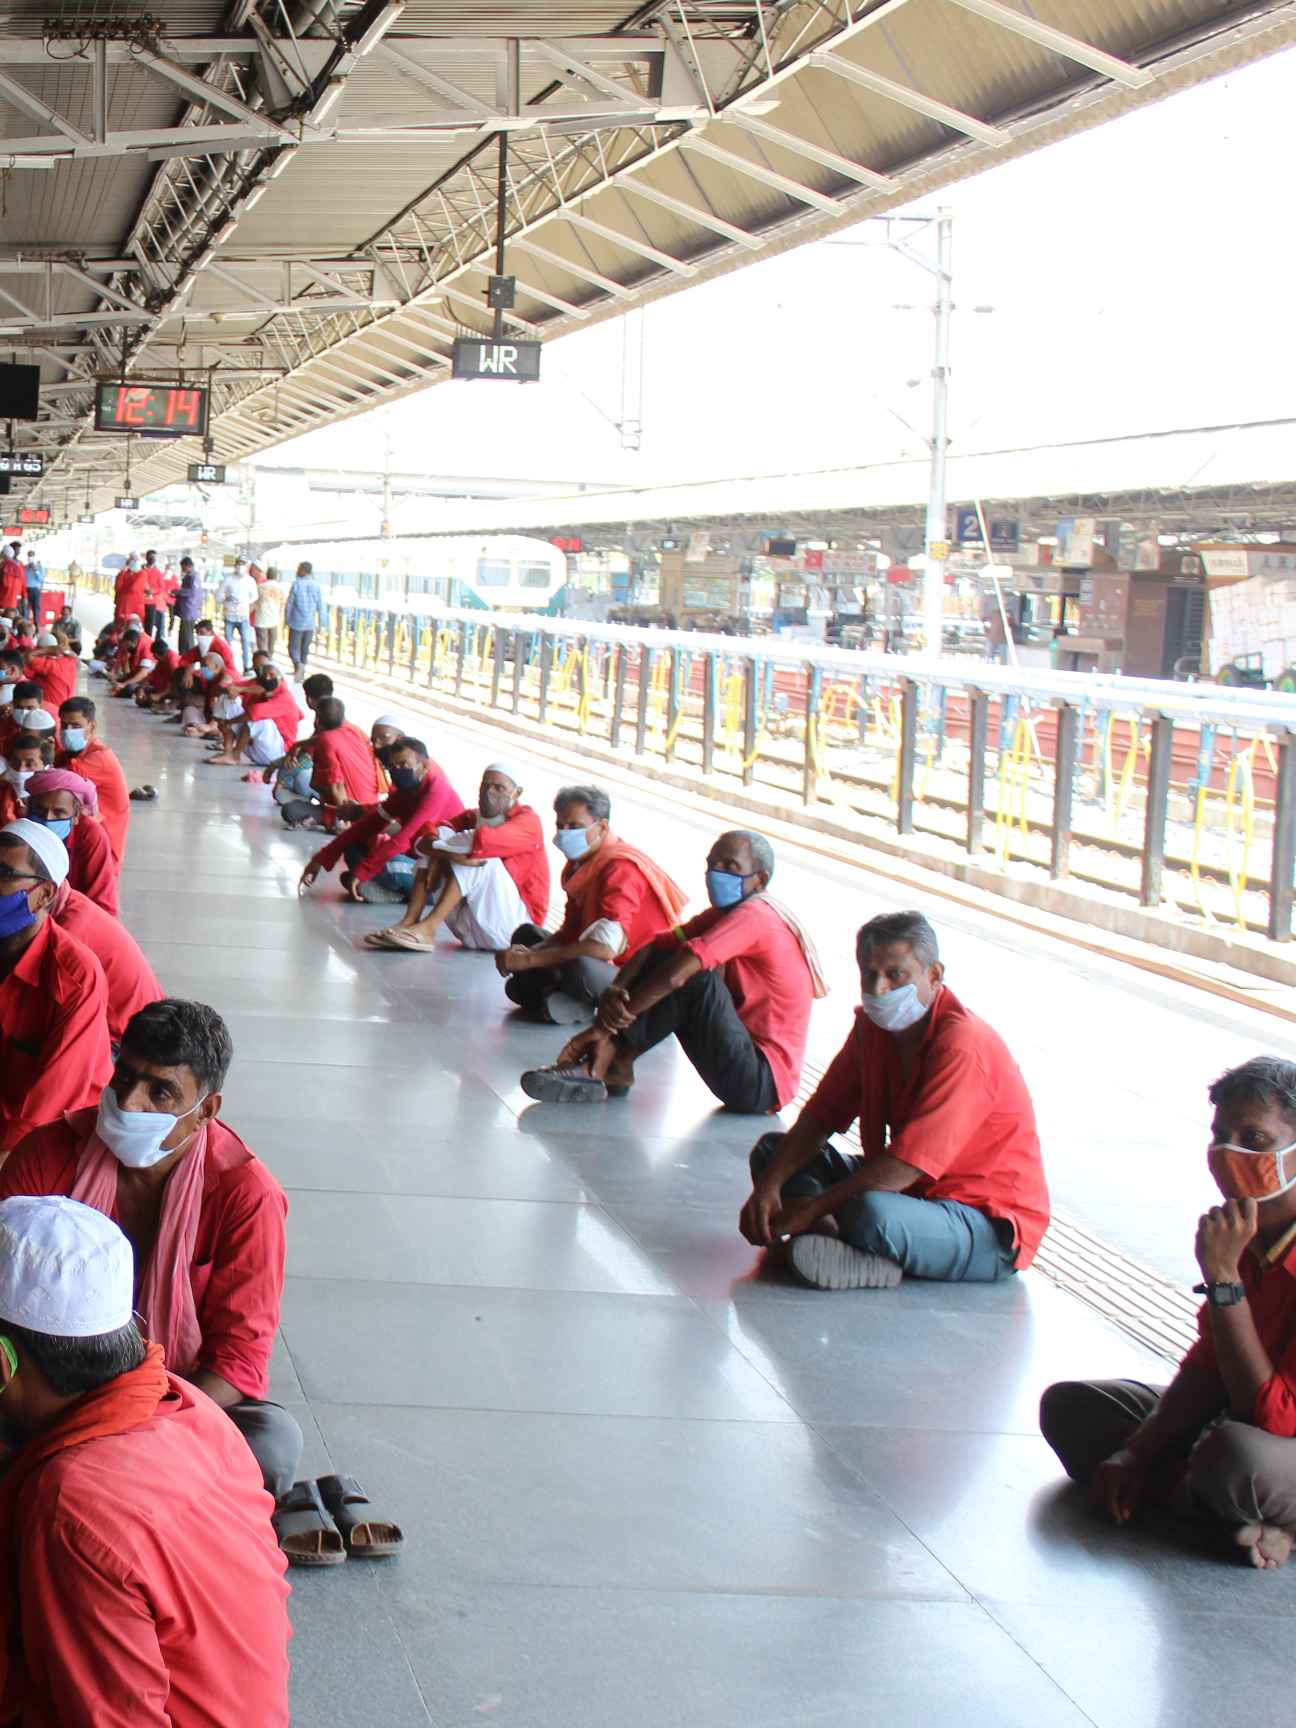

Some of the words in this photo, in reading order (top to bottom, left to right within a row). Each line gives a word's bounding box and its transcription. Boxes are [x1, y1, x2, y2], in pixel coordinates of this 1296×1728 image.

[479, 344, 518, 374] WR
[114, 386, 201, 426] 12:14
[197, 465, 217, 481] WR
[964, 515, 978, 538] 2
